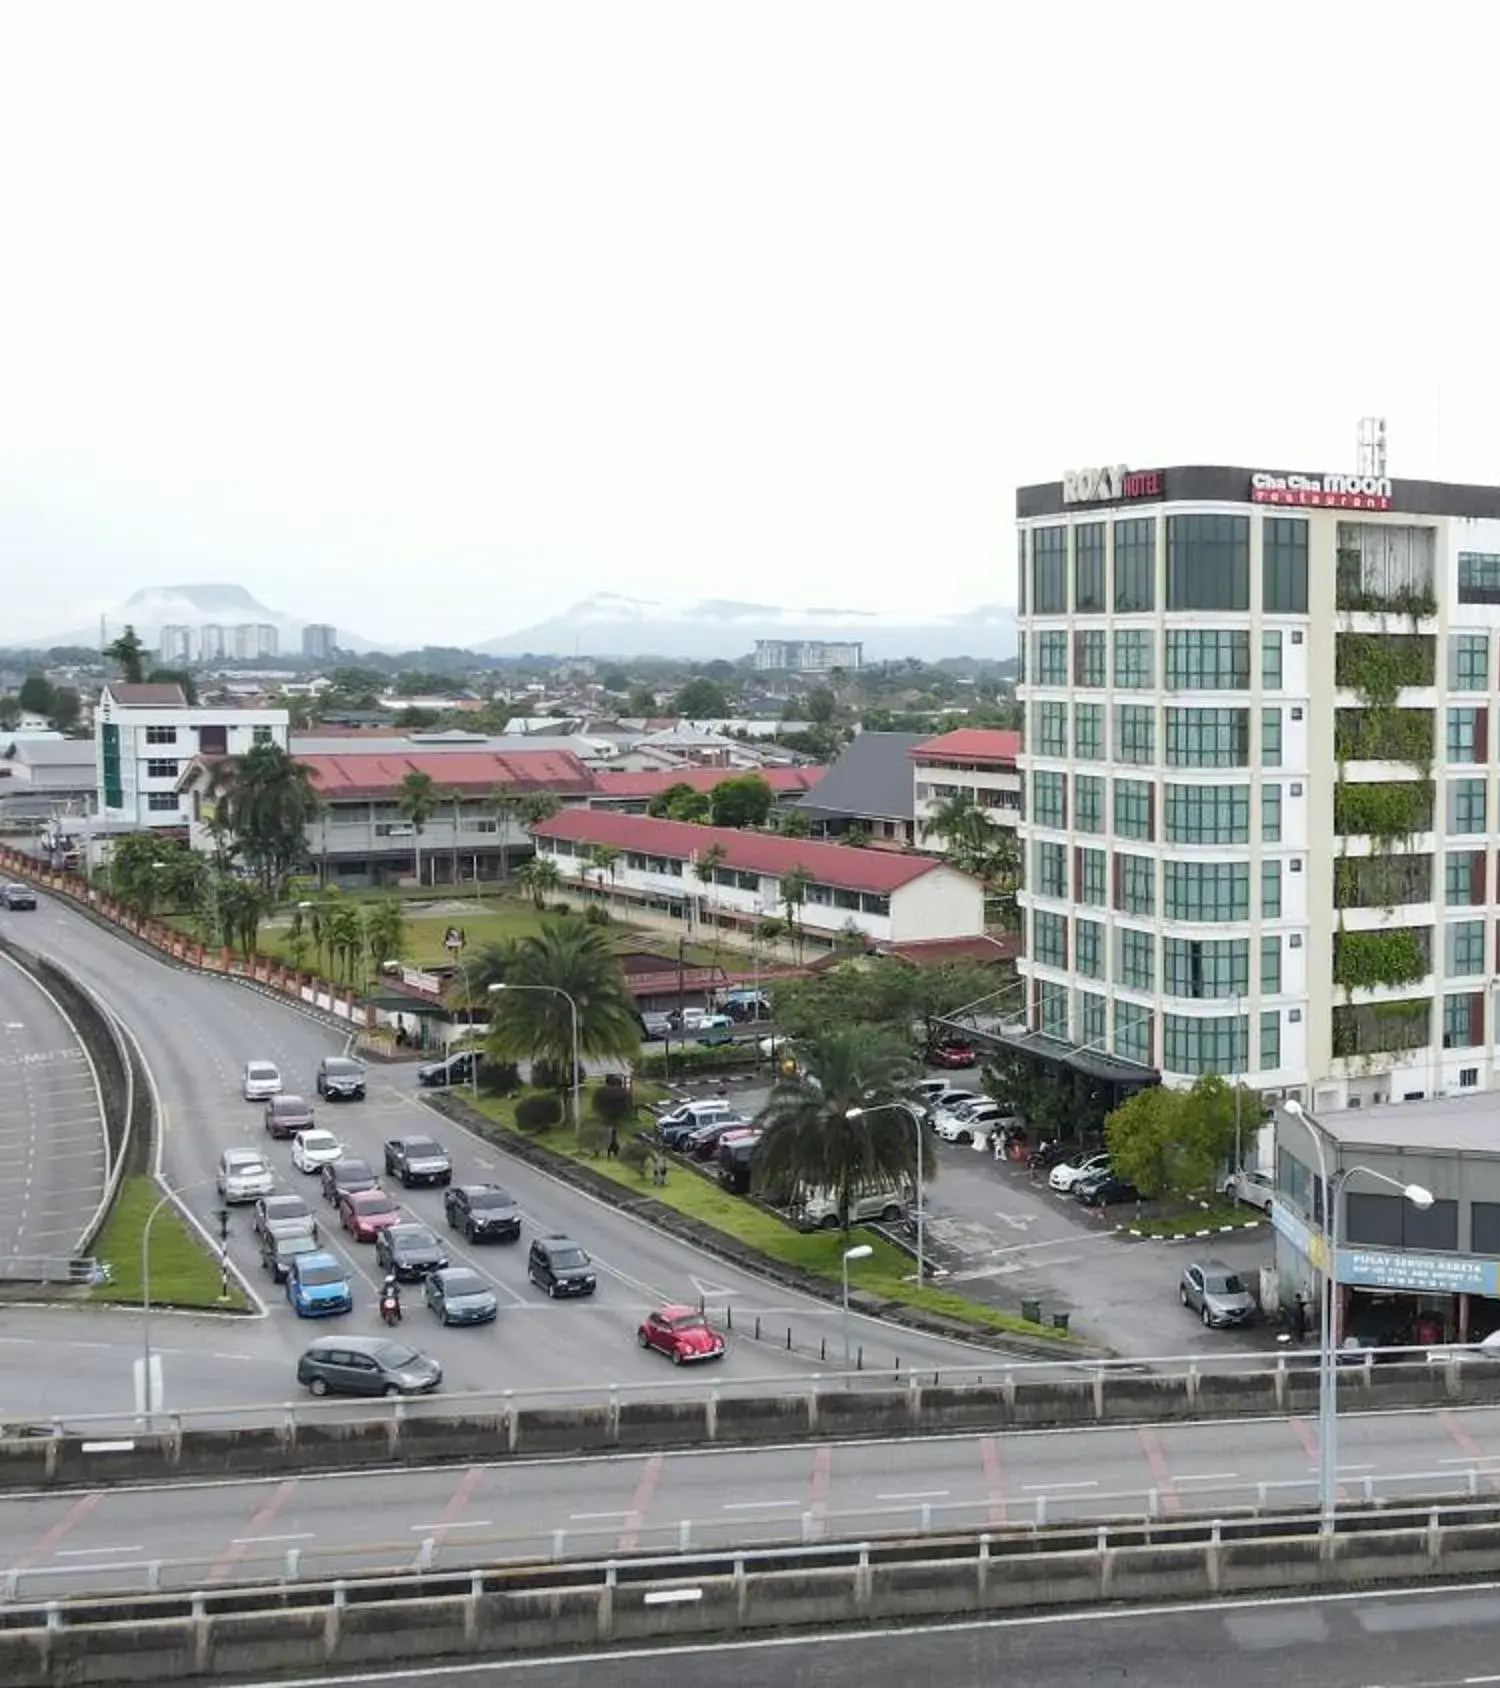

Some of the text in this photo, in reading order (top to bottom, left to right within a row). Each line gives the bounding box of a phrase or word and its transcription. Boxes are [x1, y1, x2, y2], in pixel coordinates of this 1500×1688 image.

[1063, 464, 1159, 502] ROXY HOTEL
[1252, 473, 1286, 489] Cha
[1288, 475, 1320, 491] Cha
